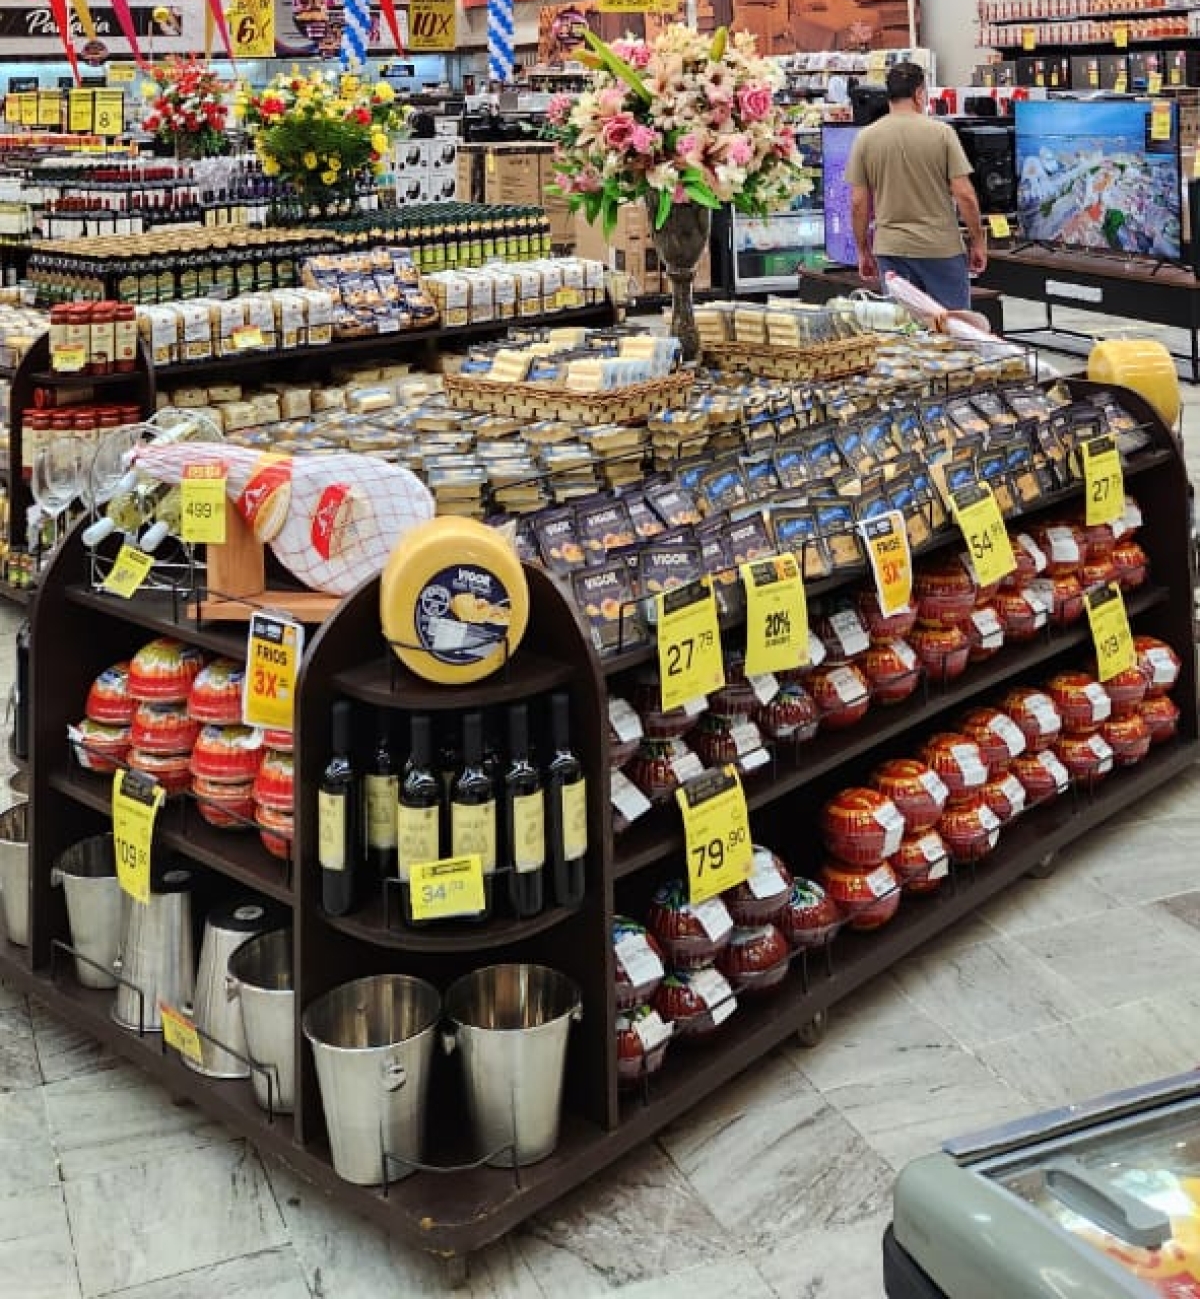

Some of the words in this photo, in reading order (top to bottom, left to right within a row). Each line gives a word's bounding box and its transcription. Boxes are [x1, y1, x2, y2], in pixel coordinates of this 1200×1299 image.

[412, 11, 454, 37] 10X
[652, 553, 688, 565] VIGOR
[765, 609, 791, 638] 20%
[257, 643, 288, 667] FRIOS
[254, 667, 277, 699] 3X
